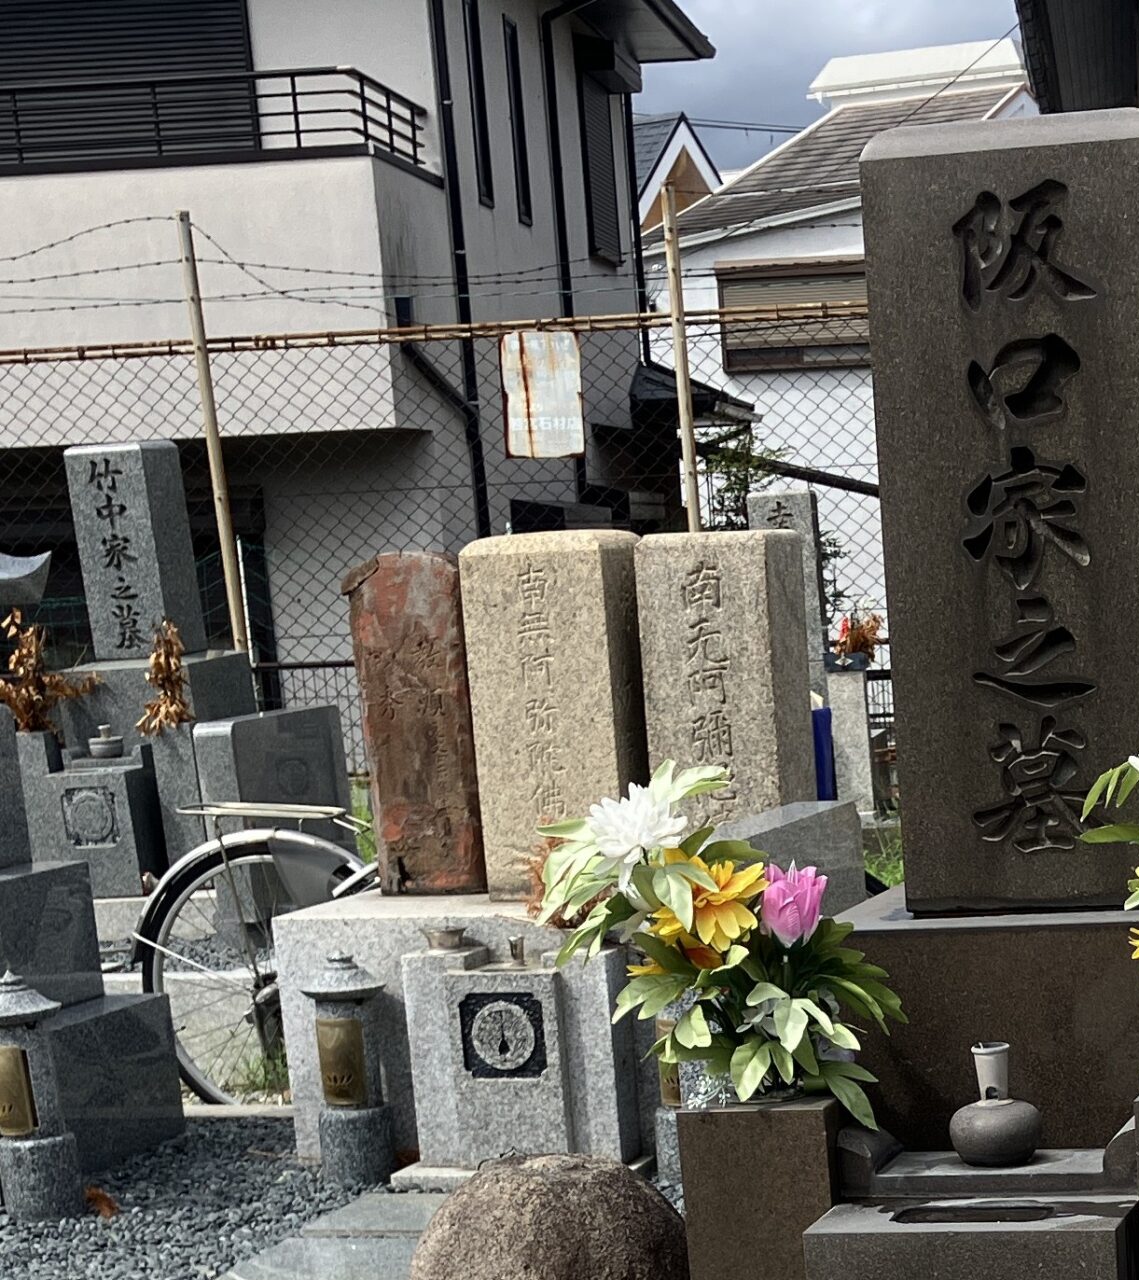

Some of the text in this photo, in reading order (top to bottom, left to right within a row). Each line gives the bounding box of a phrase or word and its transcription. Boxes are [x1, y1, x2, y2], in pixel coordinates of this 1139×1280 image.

[87, 457, 150, 649] 竹中家之墓
[951, 177, 1098, 854] 阪口家之墓
